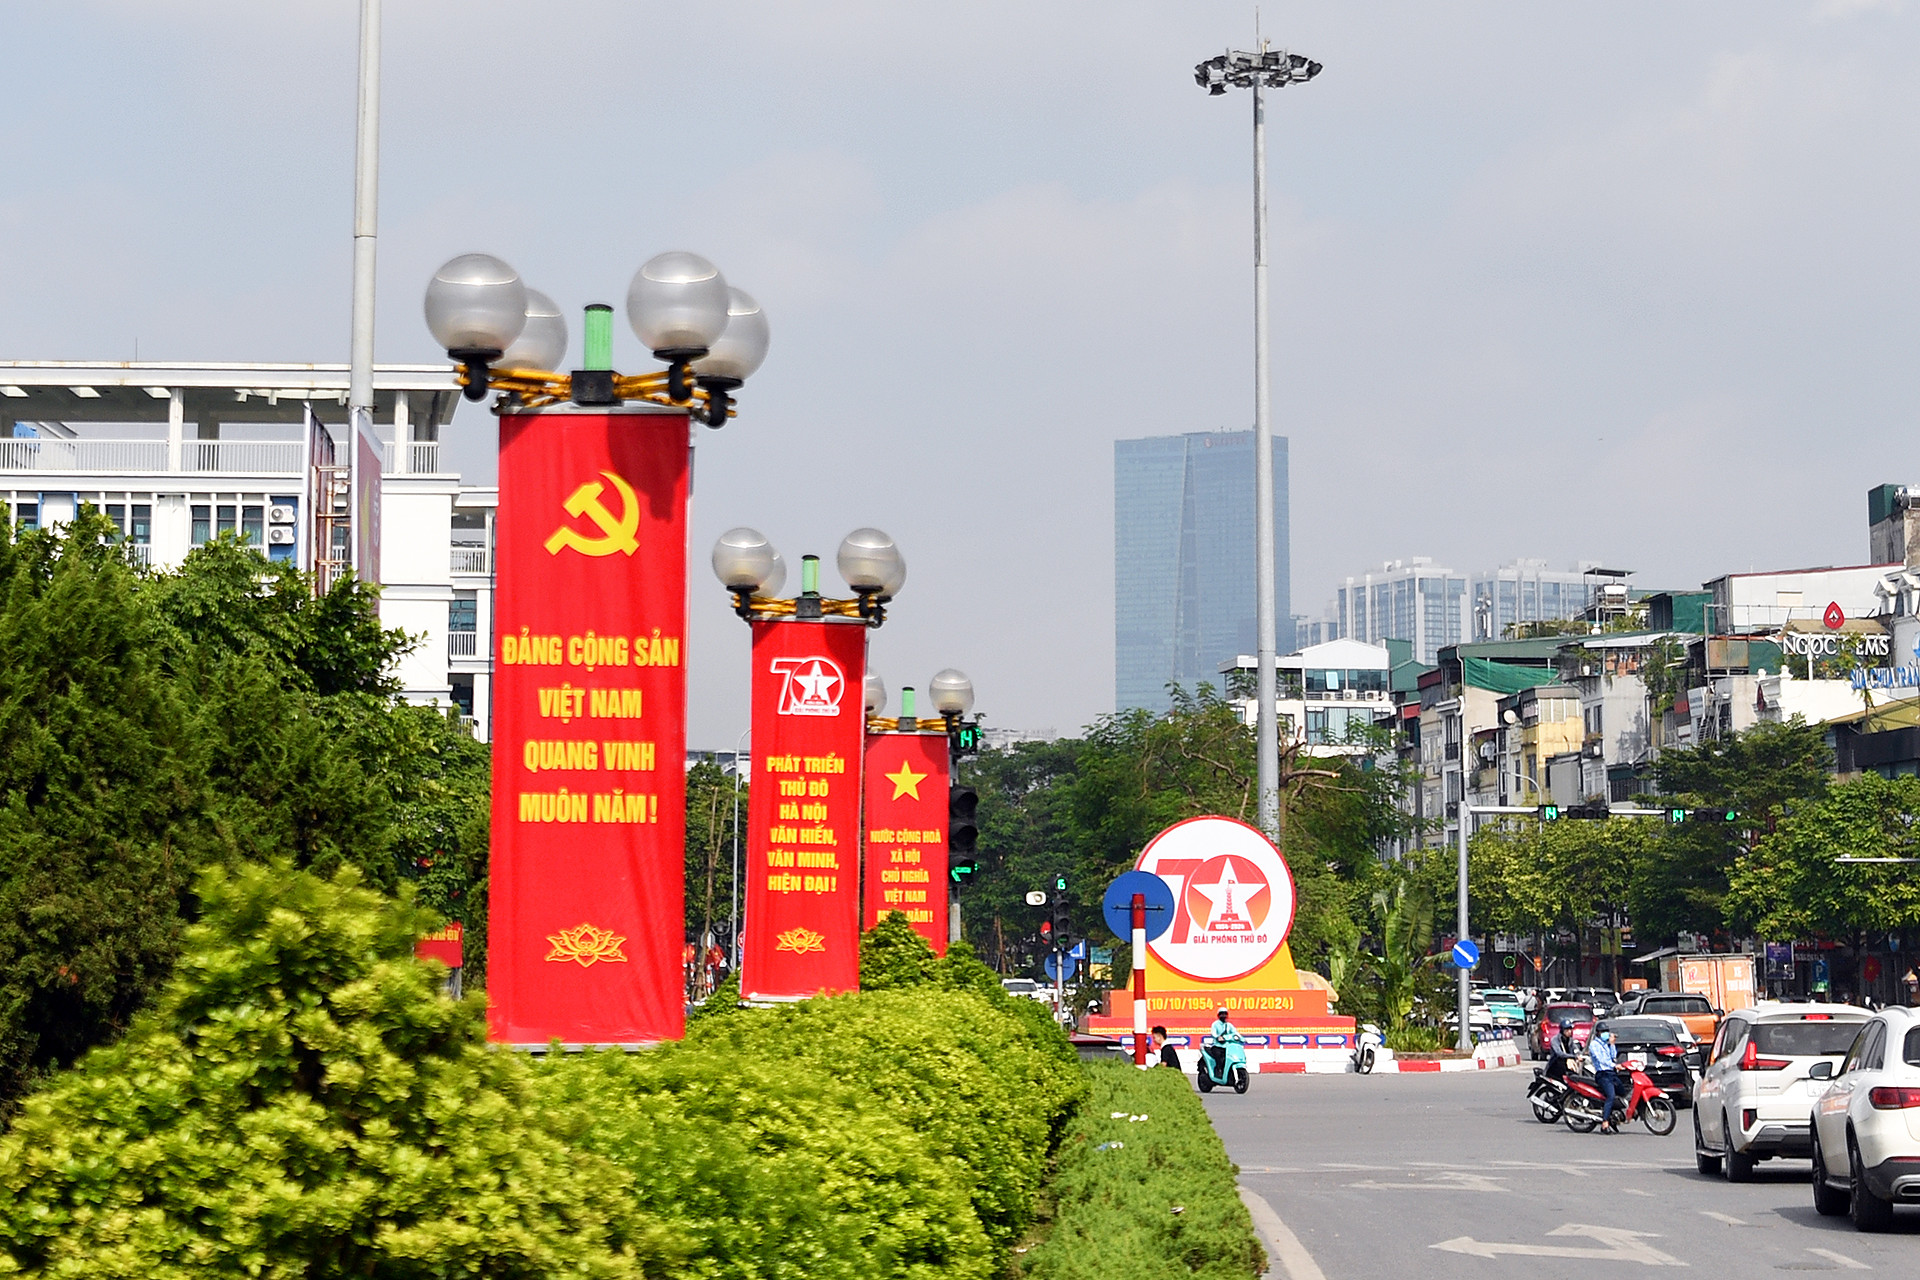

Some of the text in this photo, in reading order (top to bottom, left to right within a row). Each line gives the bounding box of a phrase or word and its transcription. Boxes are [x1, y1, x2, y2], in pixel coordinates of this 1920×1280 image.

[502, 627, 679, 672] ĐẢNG CỘNG SẢN
[1783, 637, 1889, 659] NGỌC EMS
[538, 683, 642, 724] VIỆT NAM
[523, 740, 655, 772] QUANG VINH
[766, 752, 845, 774] PHÁT TRIỂN
[779, 776, 829, 797] THỦ ĐÔ
[518, 787, 658, 823] MUÔN NĂM!
[779, 801, 828, 823] HÀ NỘI
[1672, 810, 1684, 823] 14
[770, 822, 838, 846] VĂN HIẾN,
[870, 828, 942, 846] NƯỚC CỘNG HOÀ
[767, 848, 840, 871] VĂN MINH,
[905, 848, 921, 866] HỘI
[768, 872, 837, 895] HIỆN ĐẠI!
[881, 867, 930, 883] CHỦ NGHĨA
[884, 888, 927, 906] VIỆT NAM
[1193, 932, 1268, 944] GIẢI PHÓNG THỦ ĐÔ
[1146, 997, 1214, 1011] (10/10/1954
[1224, 997, 1294, 1011] 10/10/2024)
